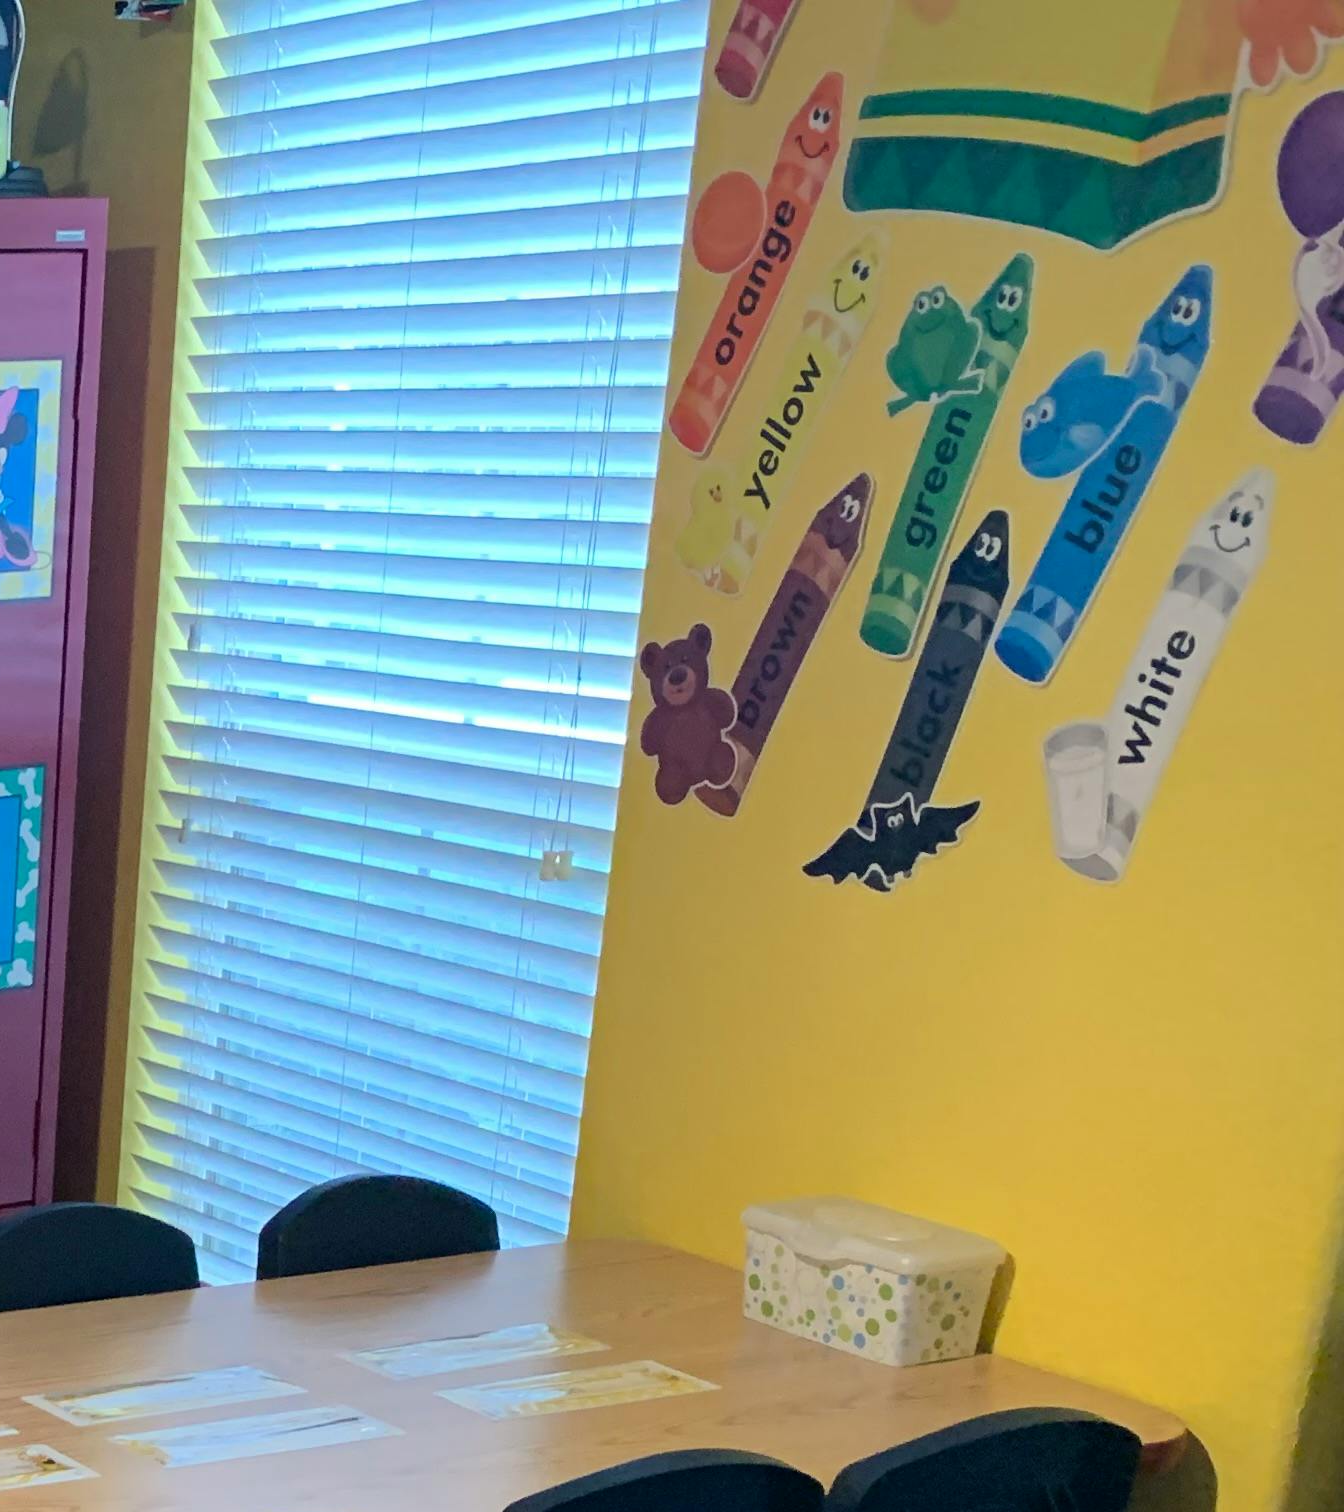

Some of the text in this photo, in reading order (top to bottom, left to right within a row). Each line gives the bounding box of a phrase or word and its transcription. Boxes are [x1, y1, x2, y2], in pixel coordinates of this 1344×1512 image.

[715, 198, 796, 367] orange
[743, 352, 823, 509] yellow
[905, 407, 972, 548] green
[1066, 442, 1141, 553] blue
[736, 591, 809, 730] brown
[890, 658, 963, 788] black
[1117, 628, 1197, 768] white
